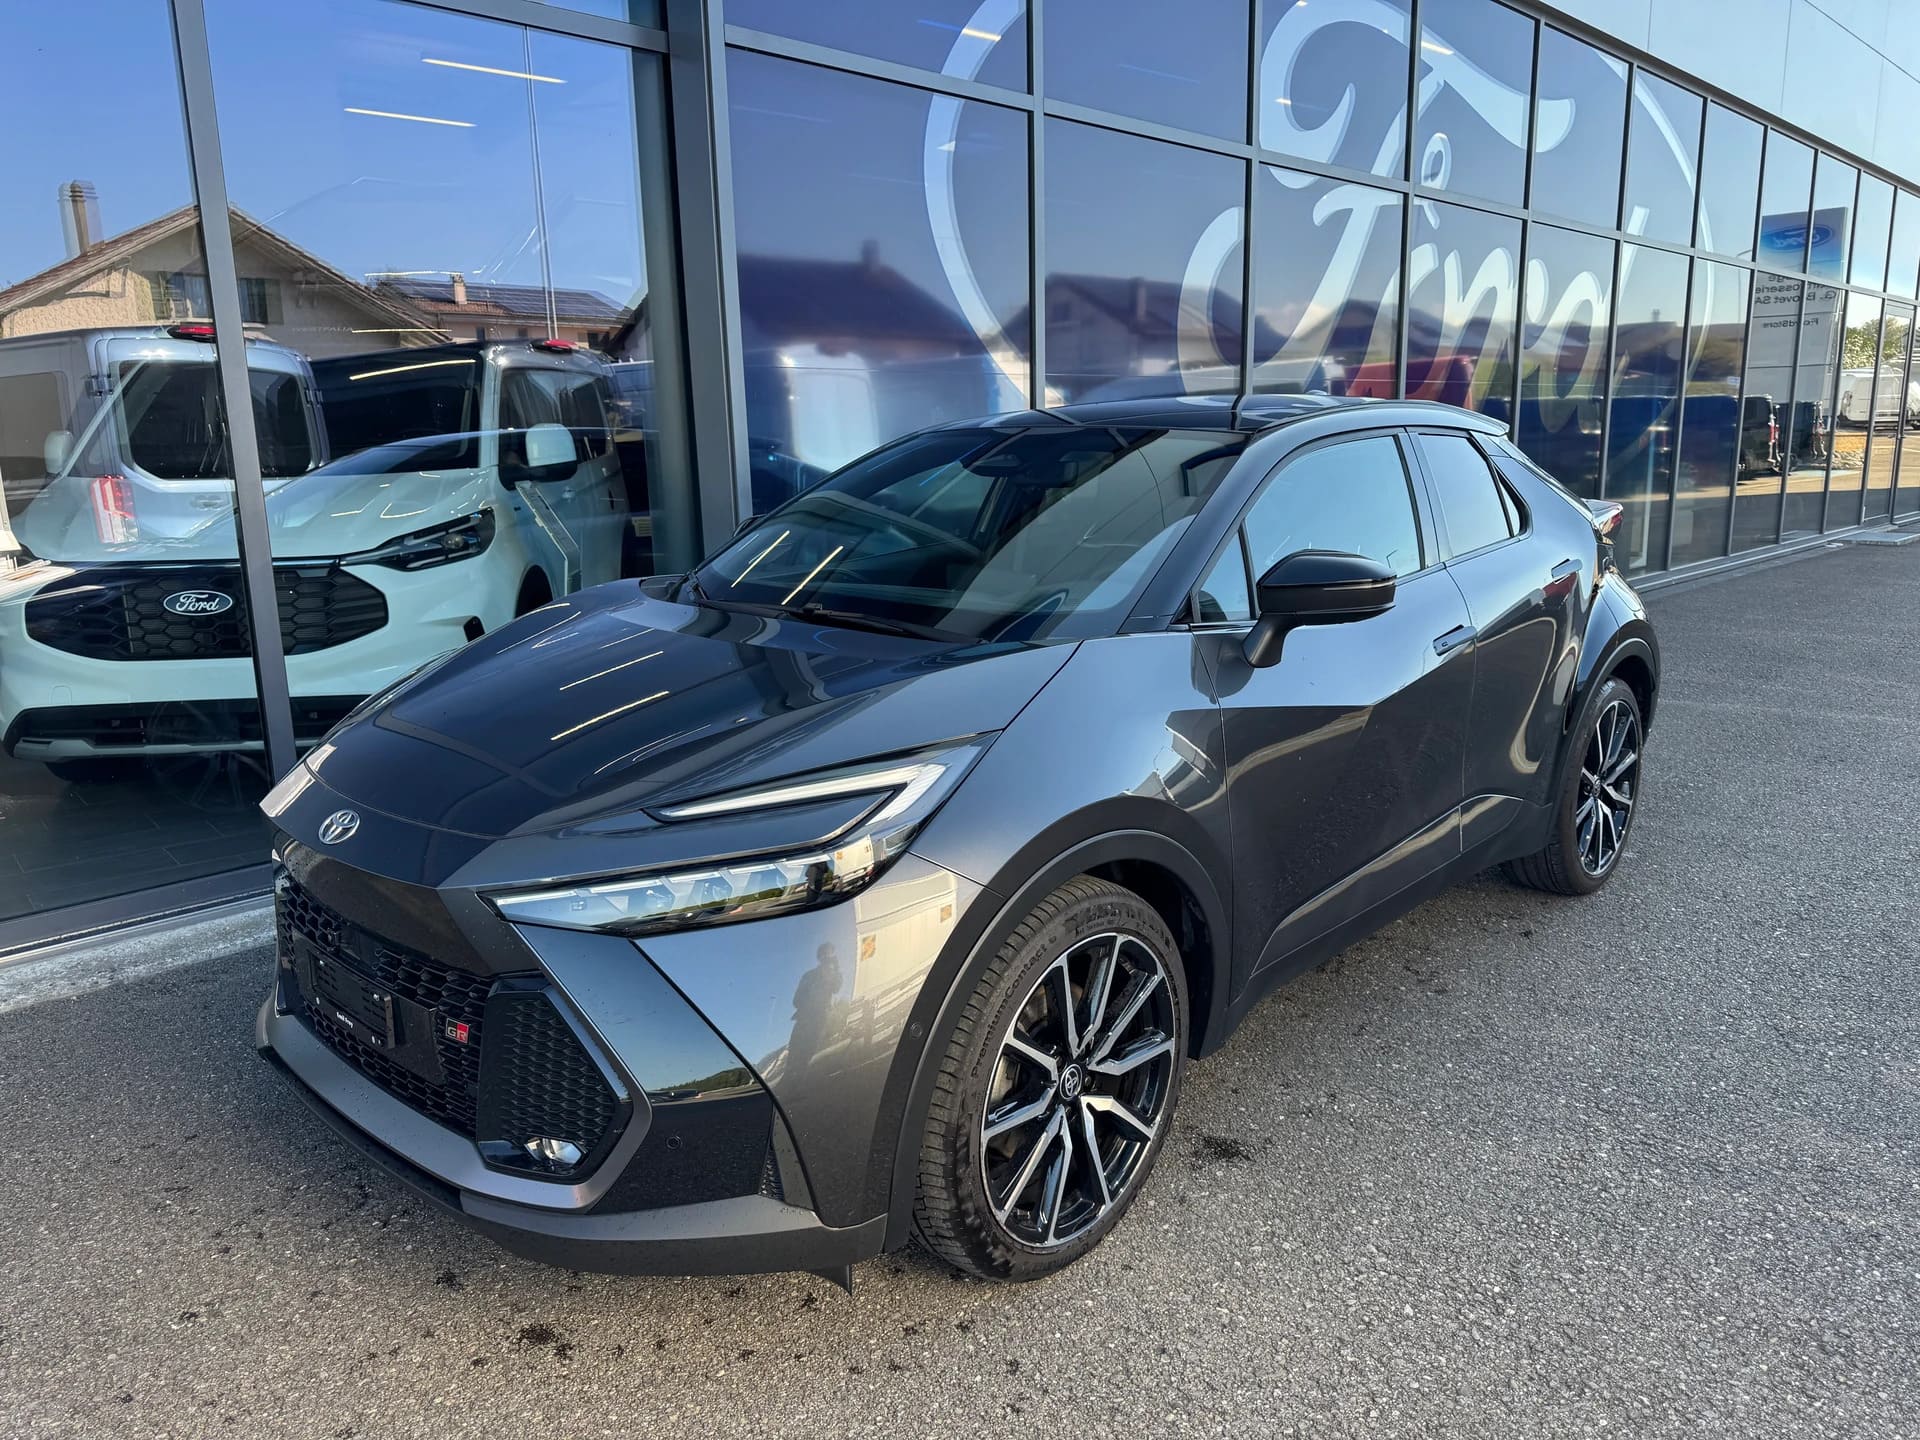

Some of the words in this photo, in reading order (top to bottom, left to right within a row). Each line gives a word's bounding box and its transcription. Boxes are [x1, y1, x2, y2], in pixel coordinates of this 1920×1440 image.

[1178, 0, 1649, 434] Ford
[176, 594, 219, 611] Ford
[447, 1024, 469, 1043] GR
